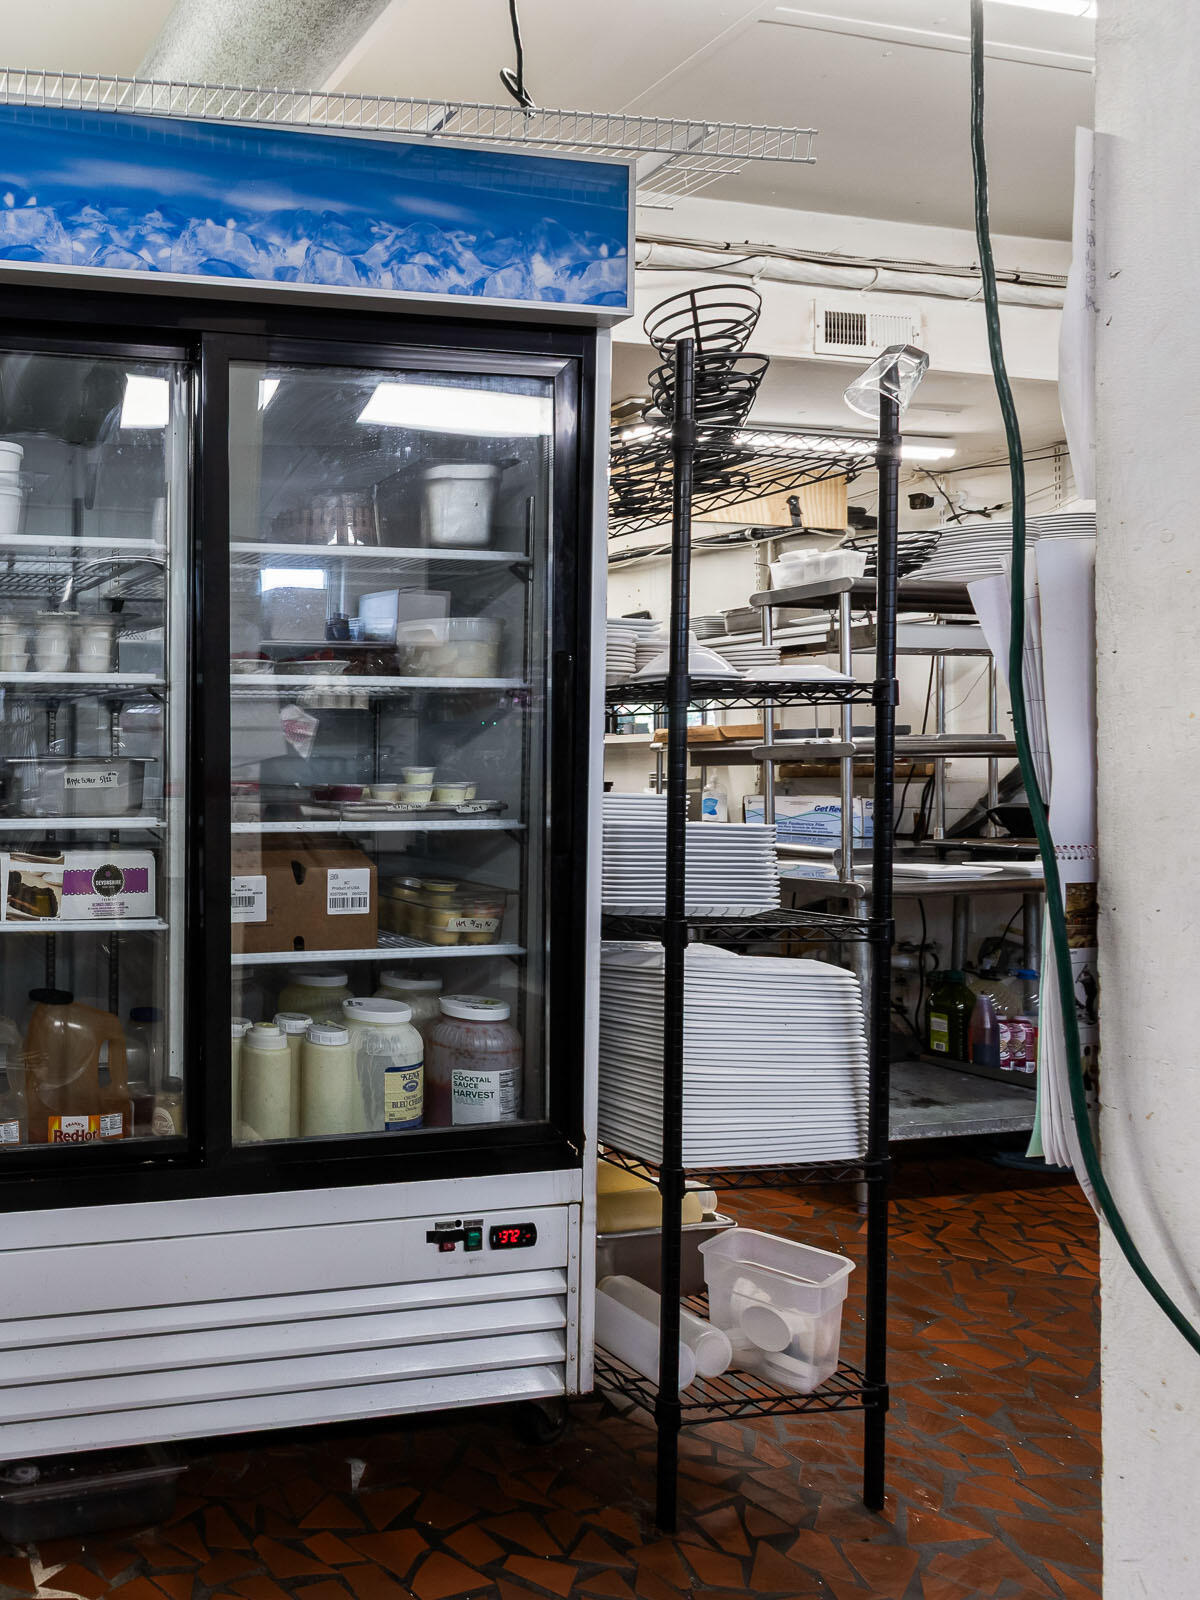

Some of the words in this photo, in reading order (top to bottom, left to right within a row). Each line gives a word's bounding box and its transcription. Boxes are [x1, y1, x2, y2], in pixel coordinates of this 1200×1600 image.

[453, 1075, 491, 1083] COCKTAIL
[453, 1089, 494, 1099] HARVEST
[54, 1129, 97, 1142] RedHot
